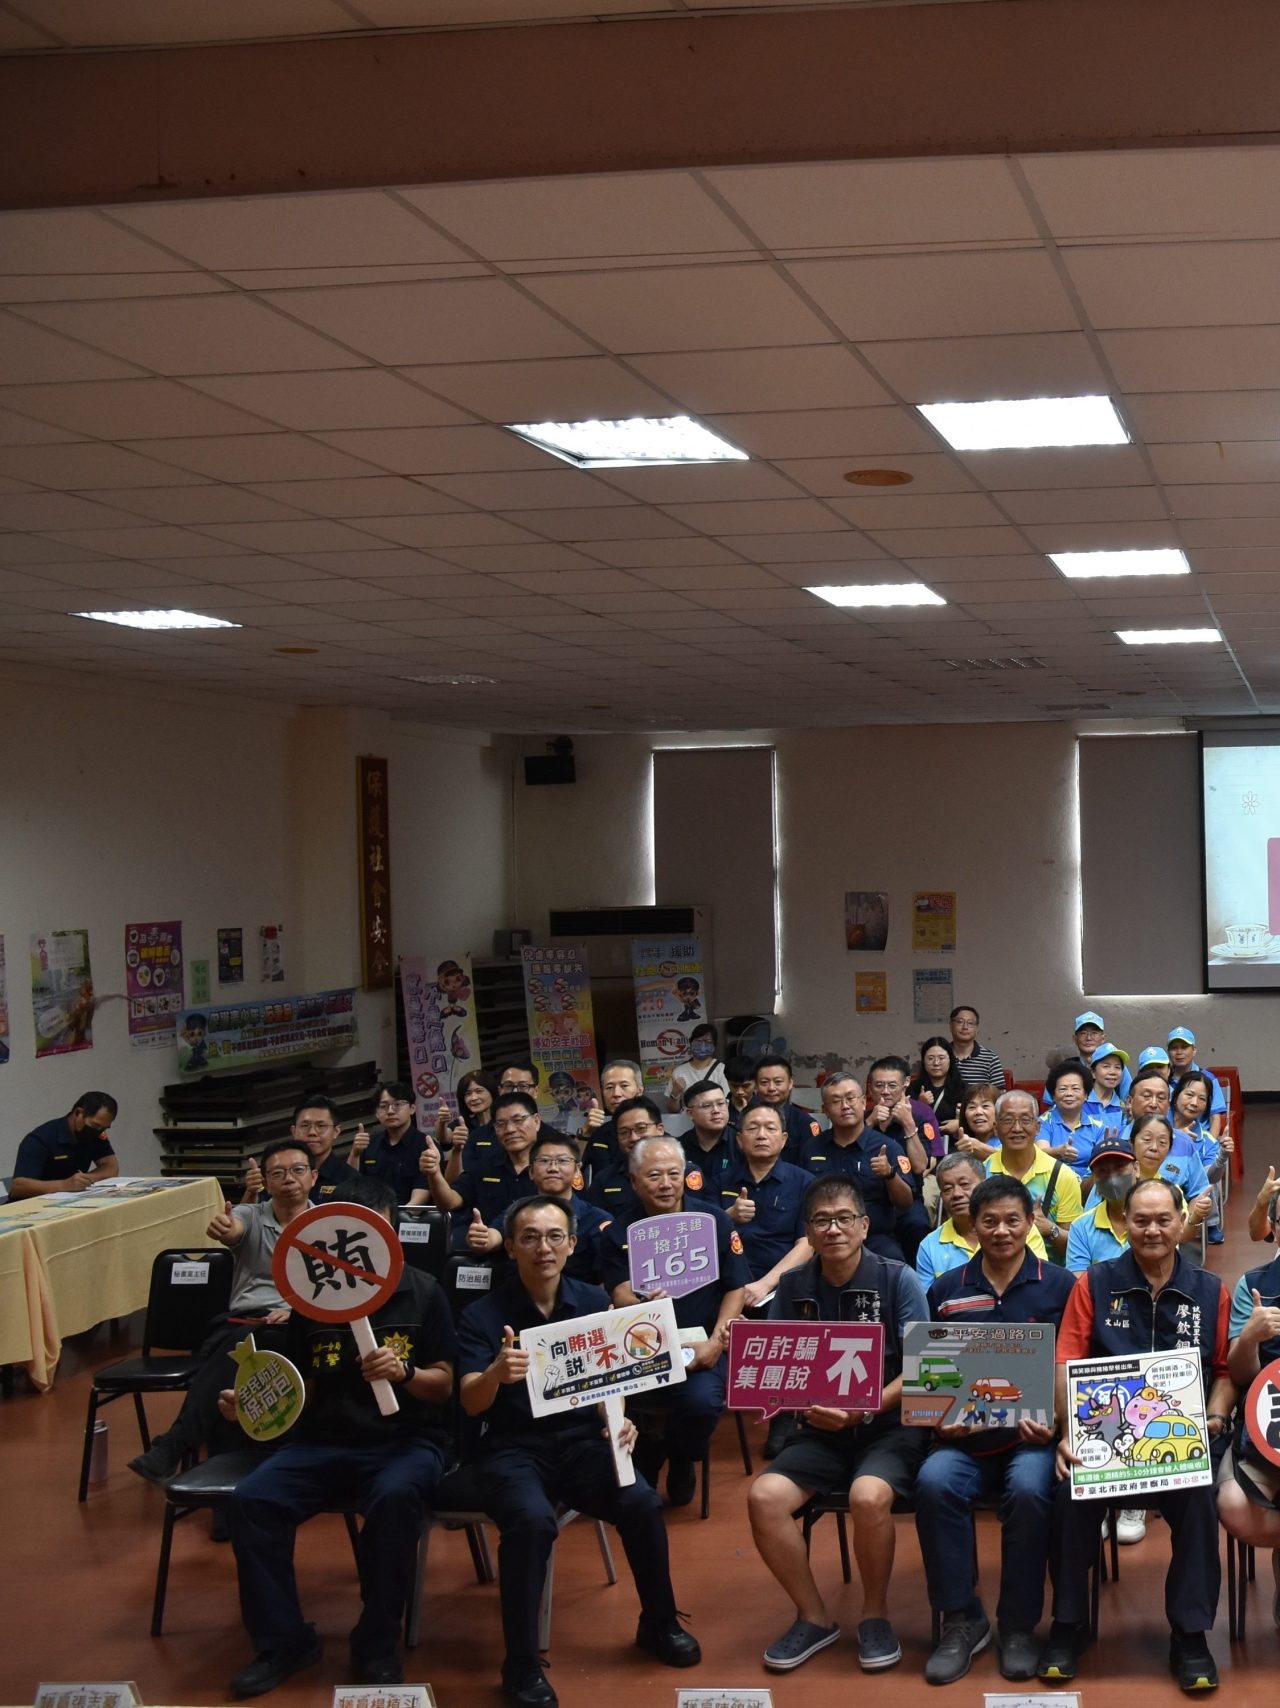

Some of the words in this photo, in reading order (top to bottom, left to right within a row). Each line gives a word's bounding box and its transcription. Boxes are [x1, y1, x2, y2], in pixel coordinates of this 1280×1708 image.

[366, 770, 388, 967] 保護社會安全
[654, 1234, 690, 1255] 撥打
[301, 1229, 376, 1300] 賄
[640, 1246, 710, 1283] 165
[458, 1274, 490, 1283] 防治組長
[953, 1327, 1044, 1341] 平安過路口
[1105, 1319, 1131, 1329] 文山區
[551, 1328, 606, 1360] 向賄選
[742, 1335, 820, 1362] 向詐騙
[239, 1360, 282, 1402] 全民防詐
[734, 1365, 812, 1391] 集團說
[1088, 1479, 1169, 1495] 臺北市政府警察局
